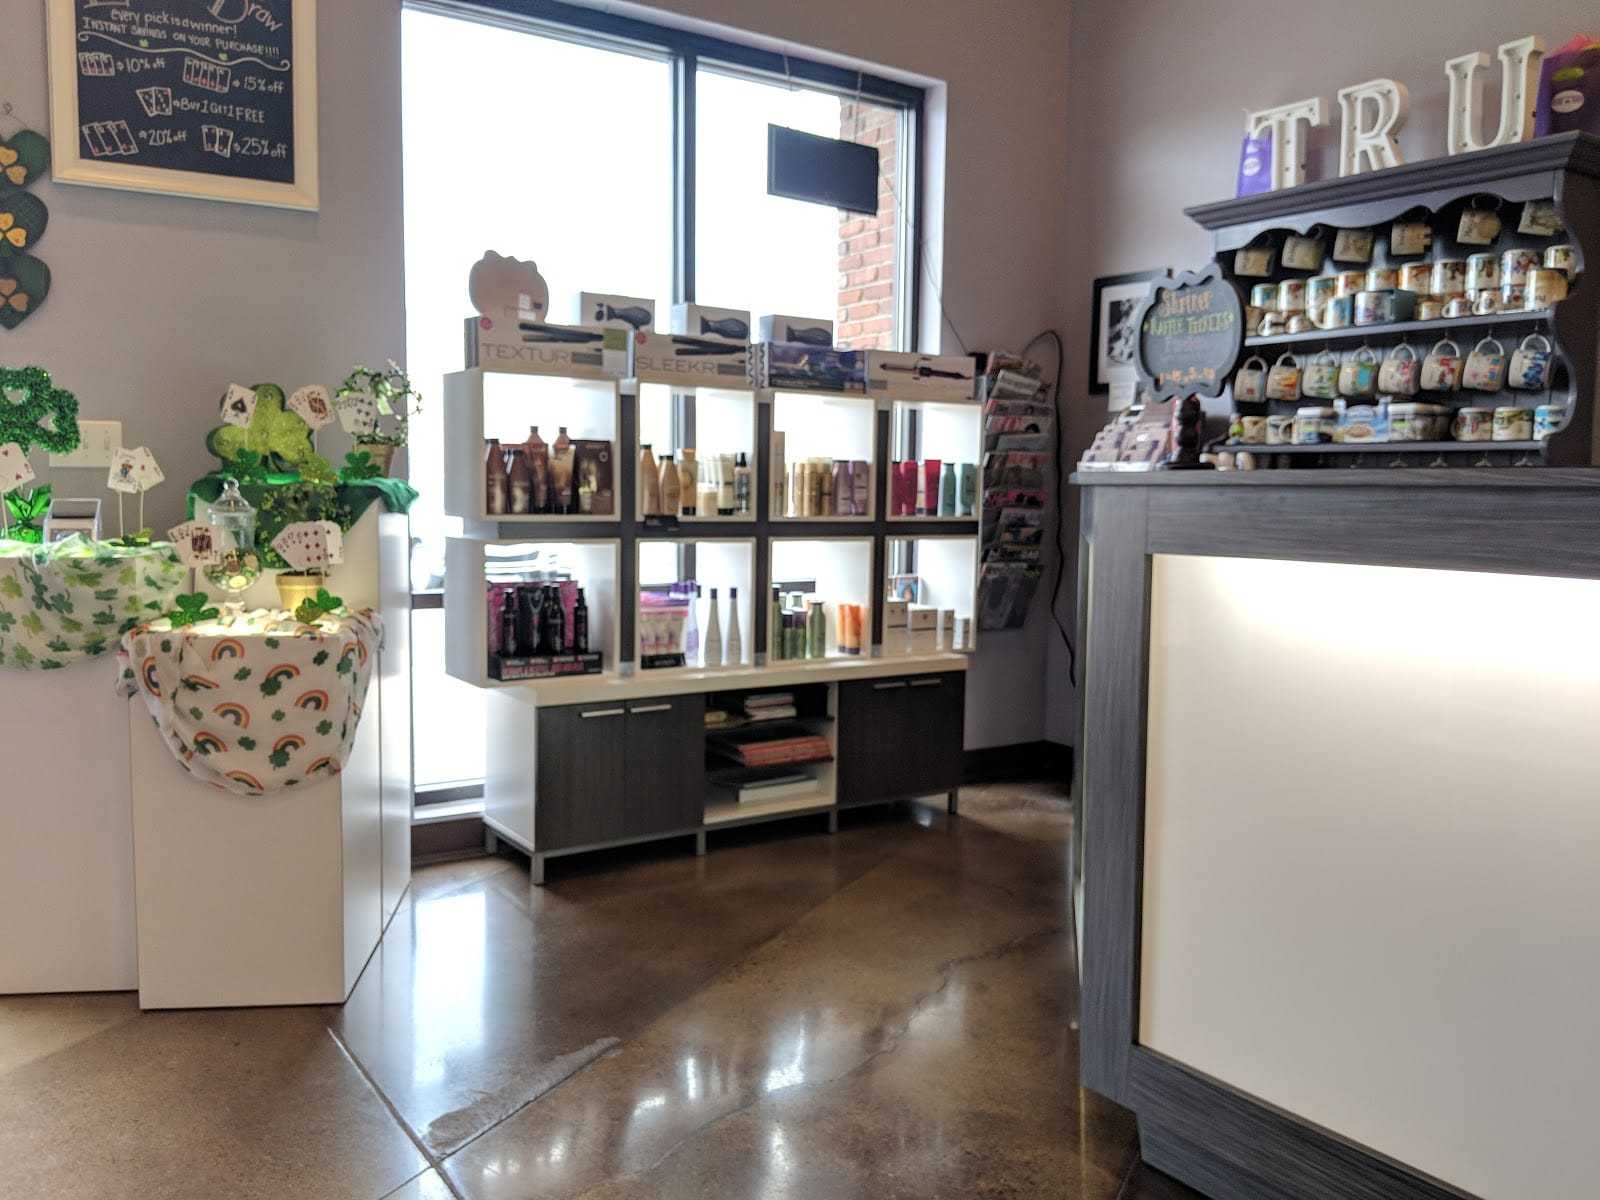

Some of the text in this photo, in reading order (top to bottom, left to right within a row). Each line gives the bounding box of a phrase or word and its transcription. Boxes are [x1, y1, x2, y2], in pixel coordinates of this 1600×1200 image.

[126, 58, 151, 73] 10%
[243, 76, 284, 94] 15% off
[235, 107, 265, 123] FREE
[148, 129, 172, 146] 20%
[241, 137, 288, 158] 25% off
